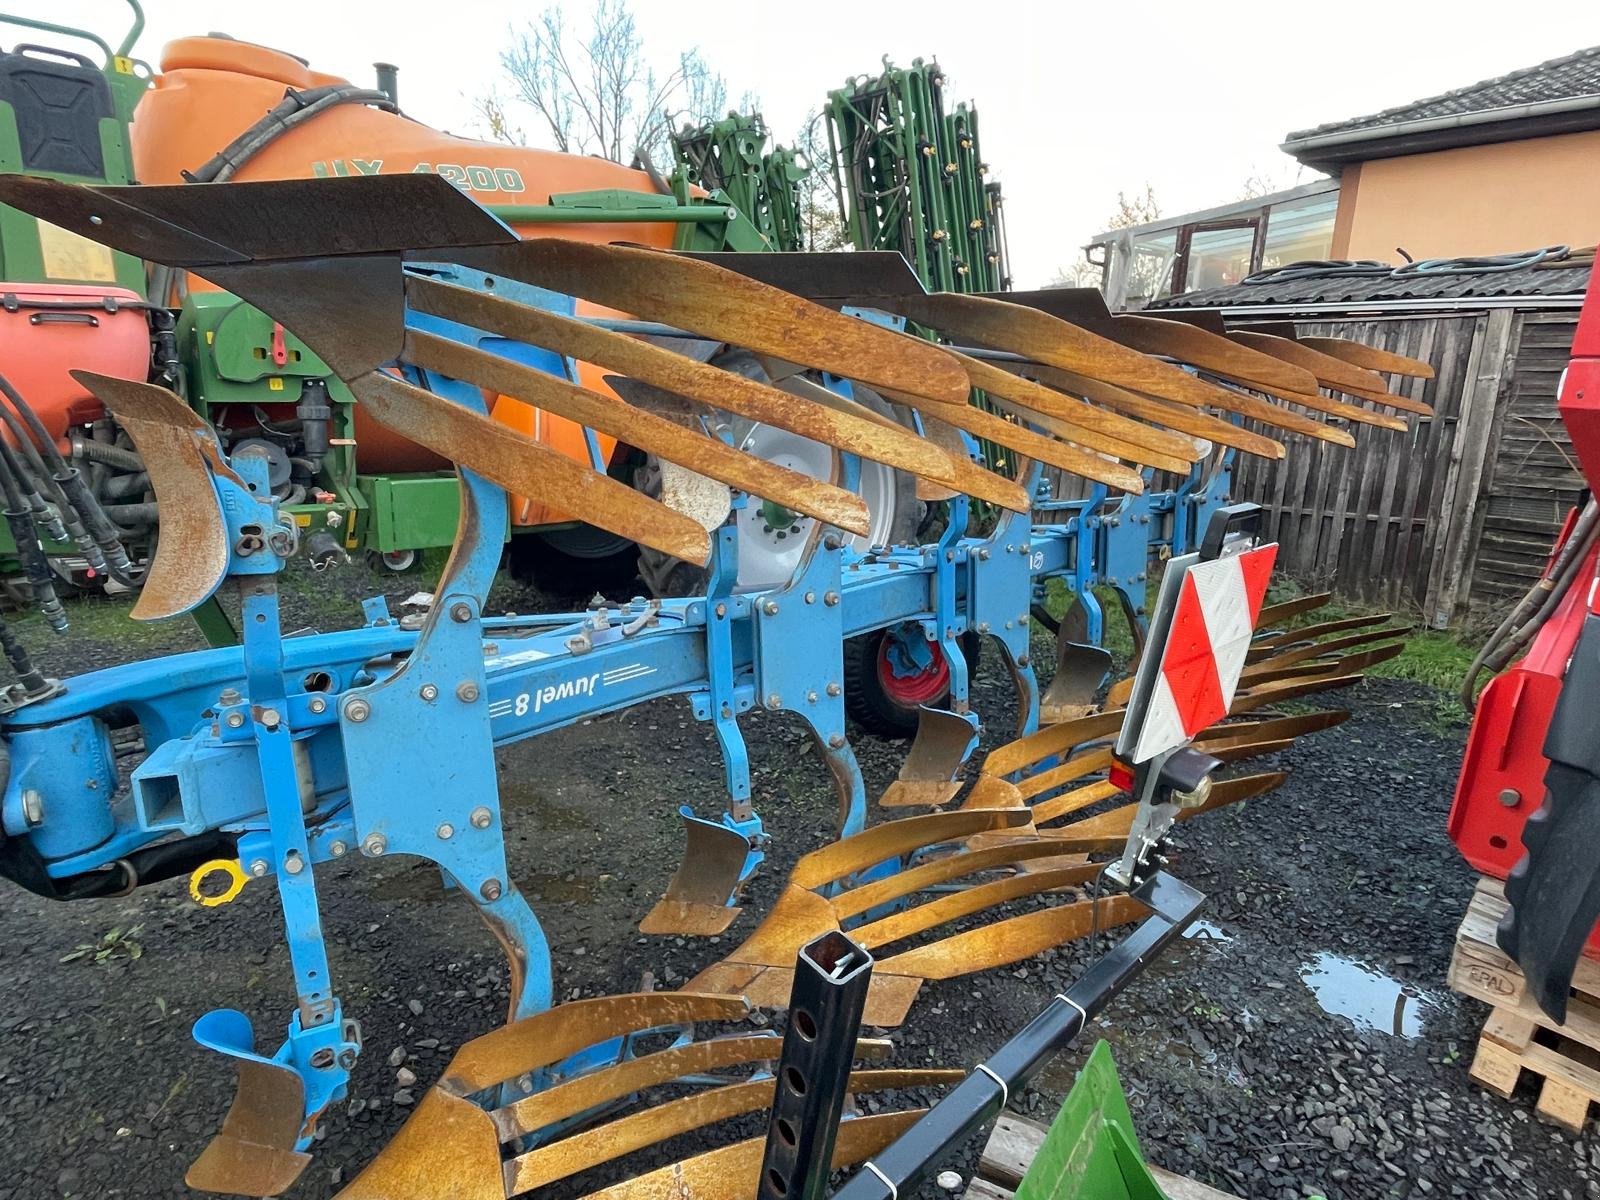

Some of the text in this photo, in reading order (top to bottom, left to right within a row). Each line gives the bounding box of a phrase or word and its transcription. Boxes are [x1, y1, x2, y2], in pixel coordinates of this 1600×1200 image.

[515, 673, 600, 717] Juwel 8
[1470, 967, 1508, 993] EPAL
